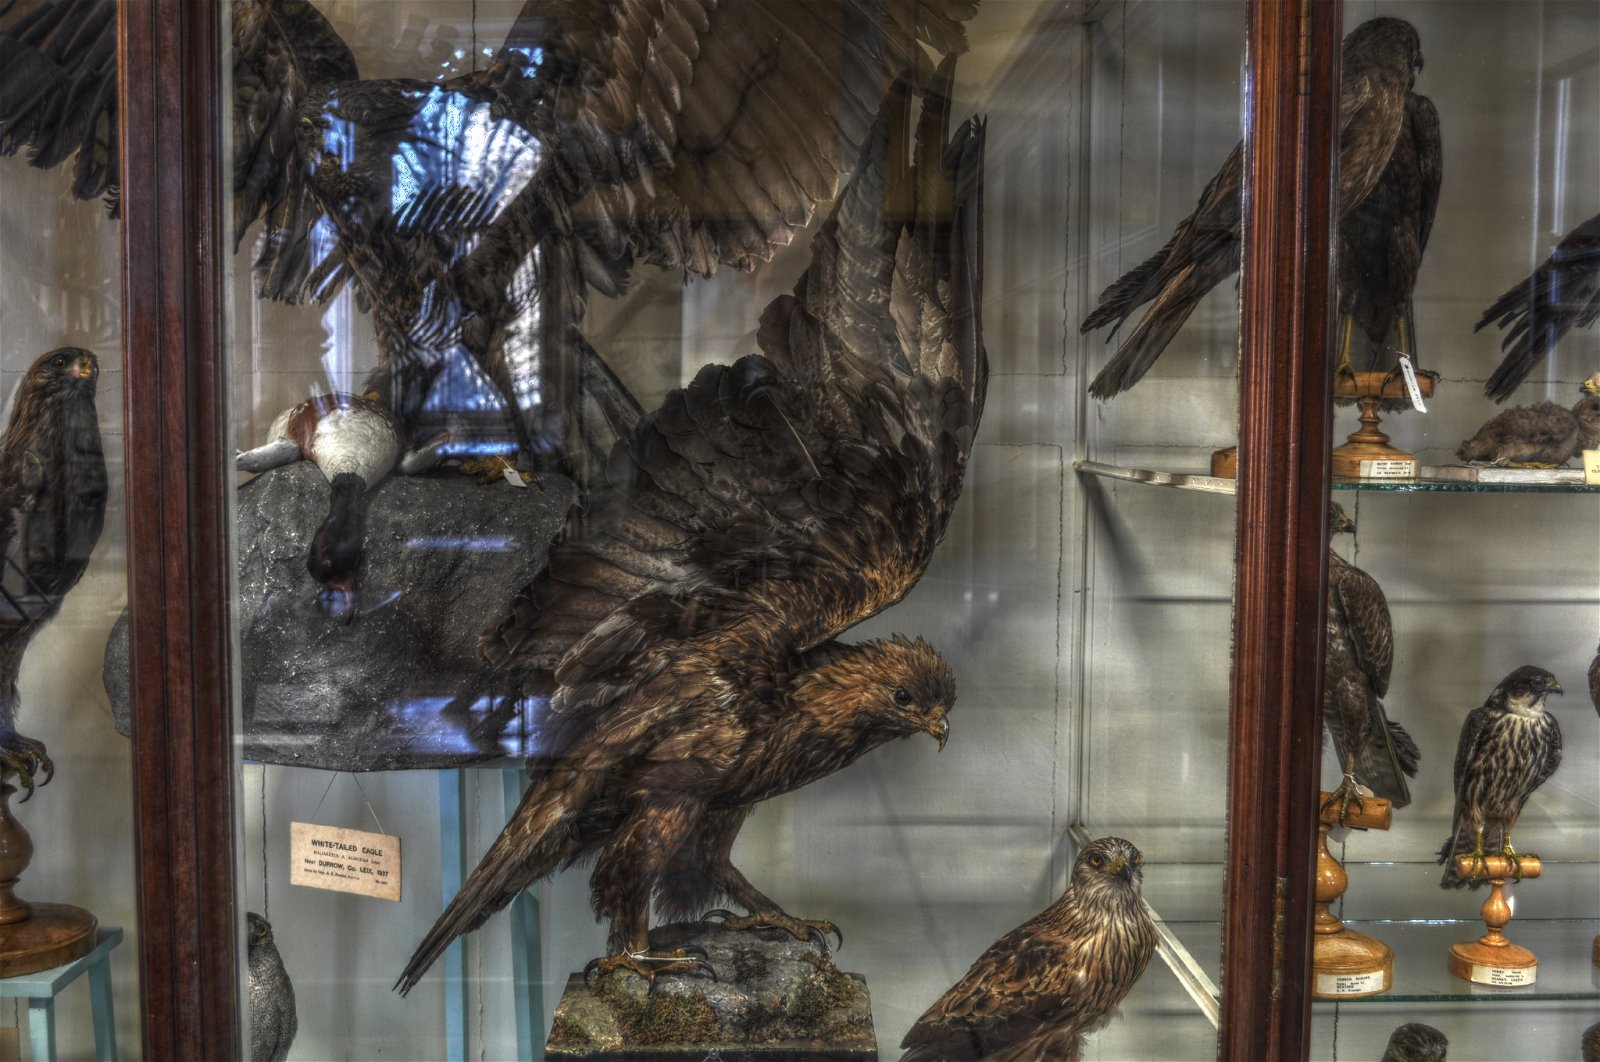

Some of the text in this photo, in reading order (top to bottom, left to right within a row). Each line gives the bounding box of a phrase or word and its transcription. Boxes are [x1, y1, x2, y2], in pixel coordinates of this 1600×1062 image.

[311, 839, 383, 857] WHITE-TAILED EAGLE
[318, 860, 345, 870] DURROW,
